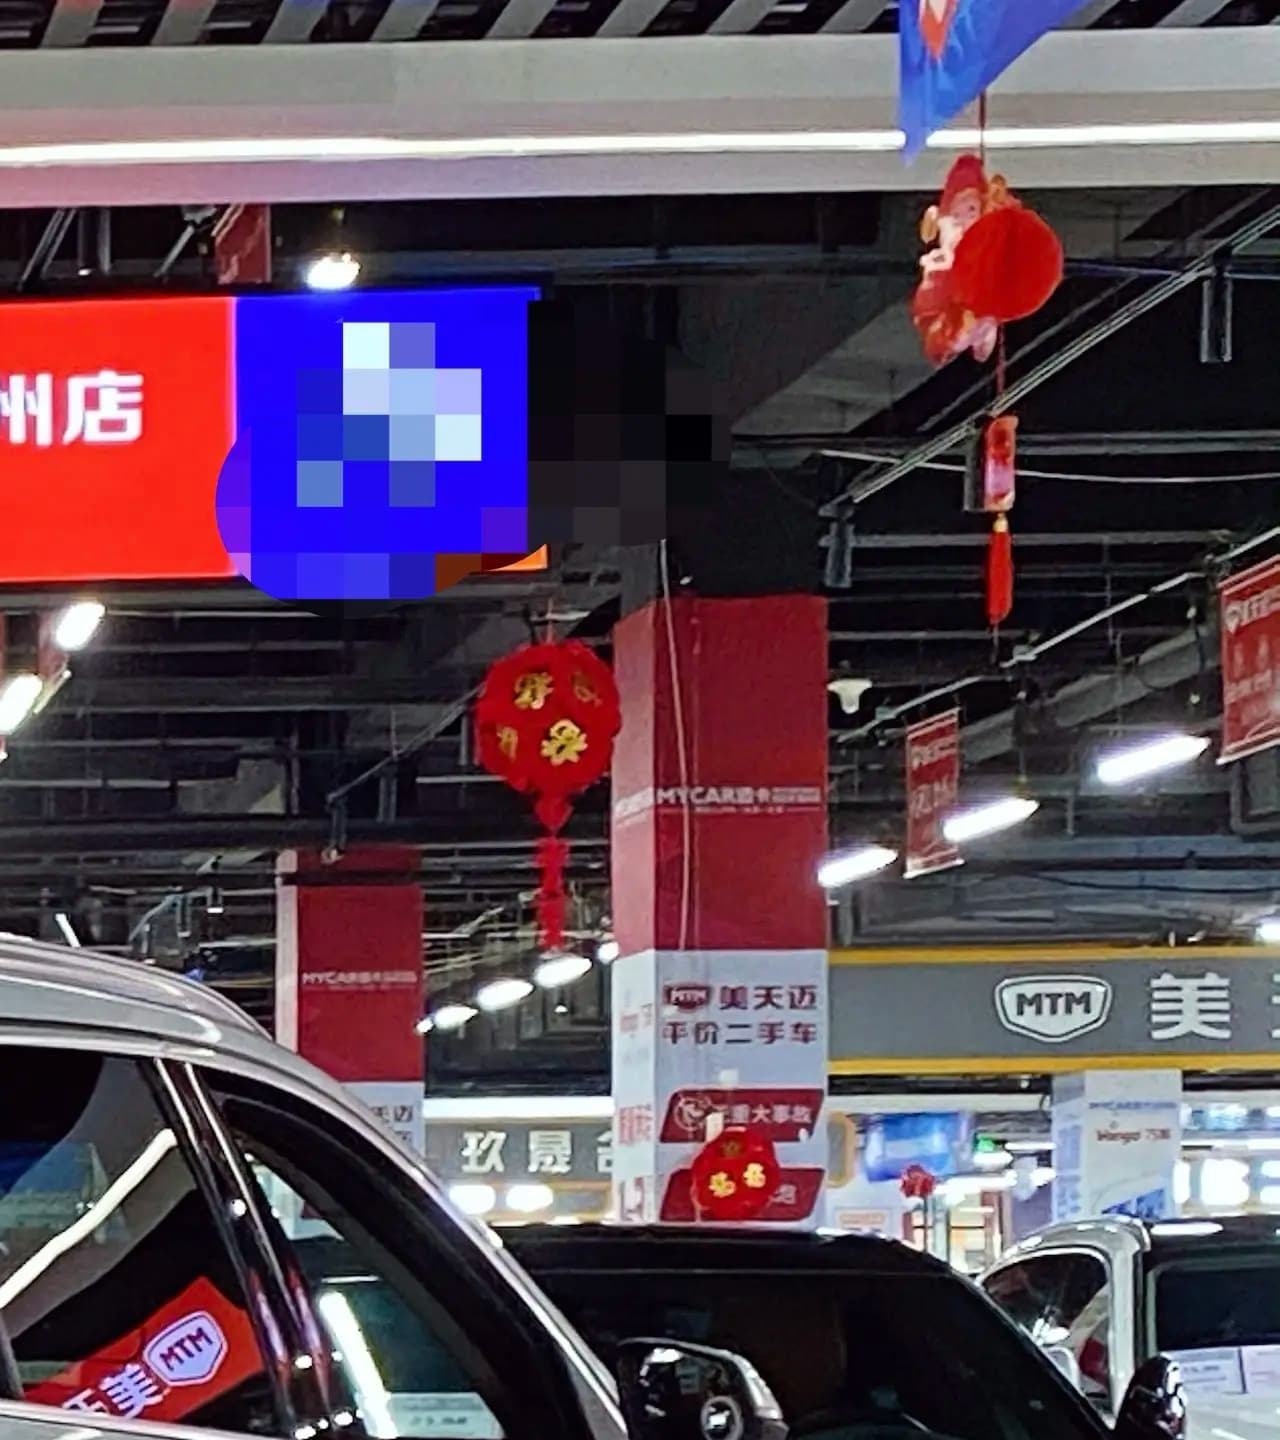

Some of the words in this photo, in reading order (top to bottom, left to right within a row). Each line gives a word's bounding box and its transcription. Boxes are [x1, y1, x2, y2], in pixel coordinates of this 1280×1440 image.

[719, 985, 818, 1011] 美天迈
[1016, 991, 1091, 1017] MTM
[1150, 972, 1280, 1041] 美
[663, 1020, 818, 1045] 平价二手车
